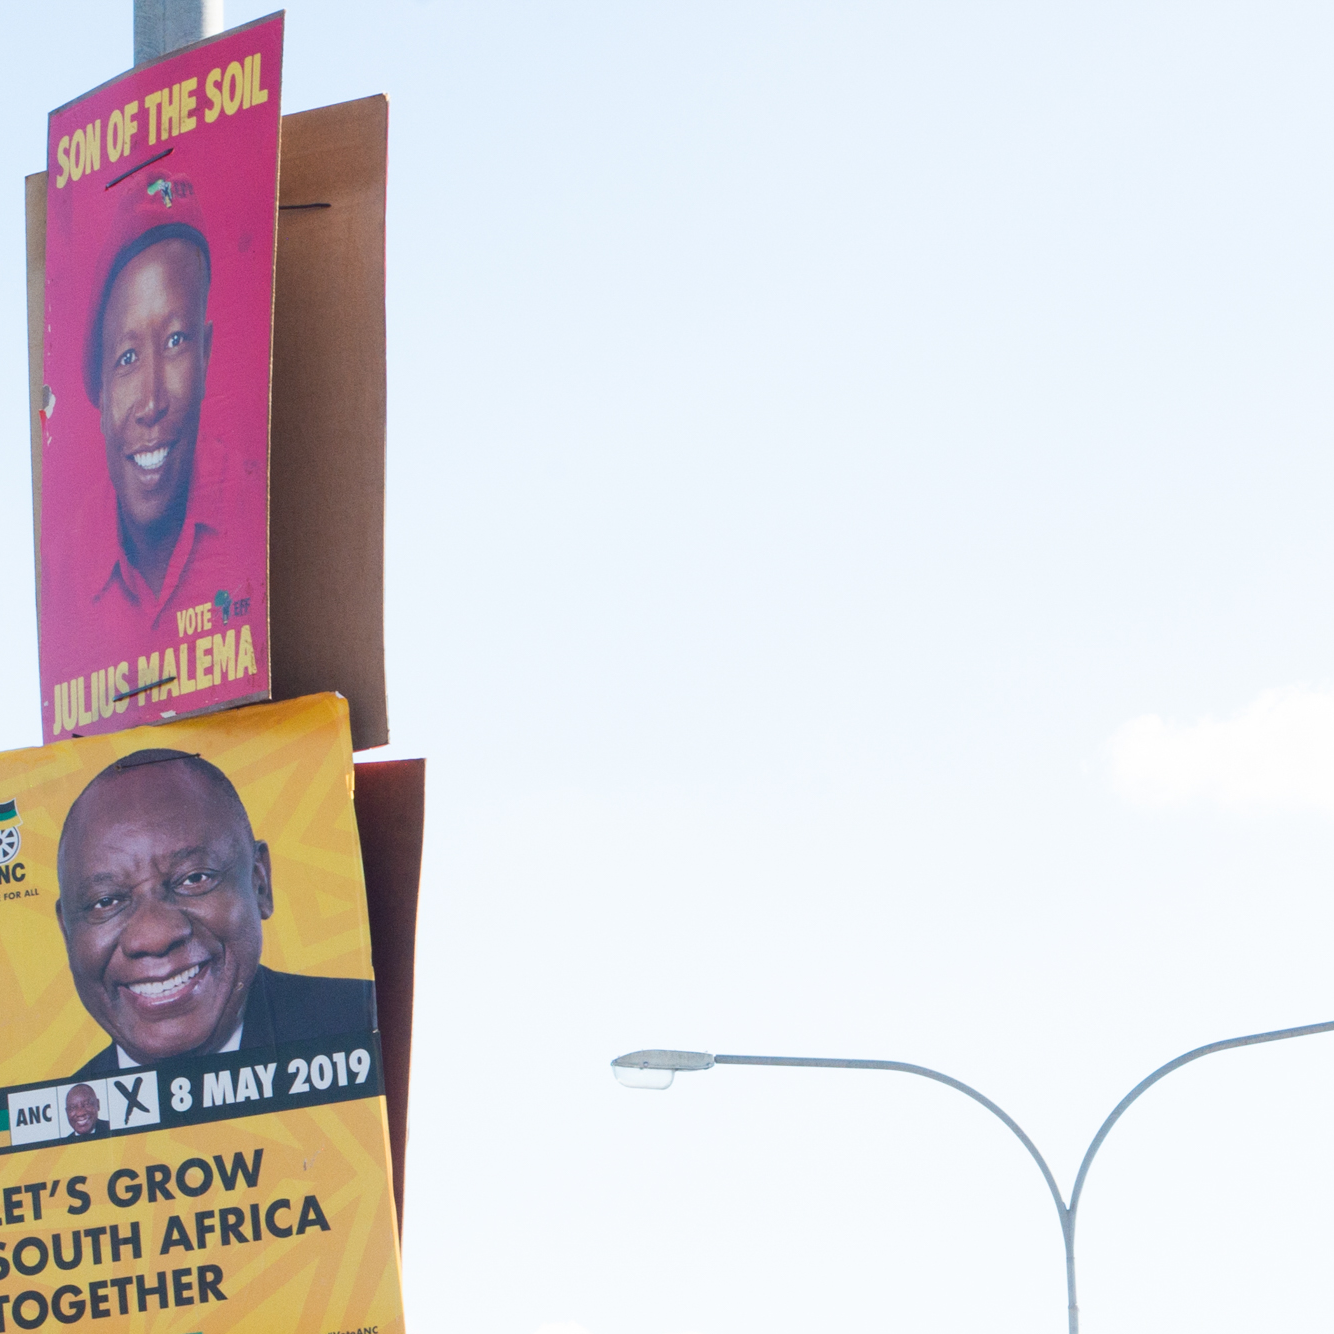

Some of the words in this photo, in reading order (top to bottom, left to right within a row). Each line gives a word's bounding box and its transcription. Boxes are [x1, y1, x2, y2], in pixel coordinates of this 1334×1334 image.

[56, 119, 101, 189] SON
[107, 100, 139, 163] OF
[145, 77, 197, 146] THE
[205, 53, 268, 124] SOIL
[177, 602, 212, 638] VOTE
[233, 597, 251, 617] EFF
[53, 661, 130, 736] JULIUS
[137, 624, 258, 707] MALEMA
[3, 890, 21, 900] FOR
[24, 888, 40, 897] ALL
[16, 1104, 53, 1127] ANC
[170, 1077, 193, 1112] 8
[202, 1063, 278, 1108] MAY
[287, 1048, 371, 1095] 2019
[107, 1148, 264, 1208] GROW
[159, 1194, 331, 1255] AFRICA
